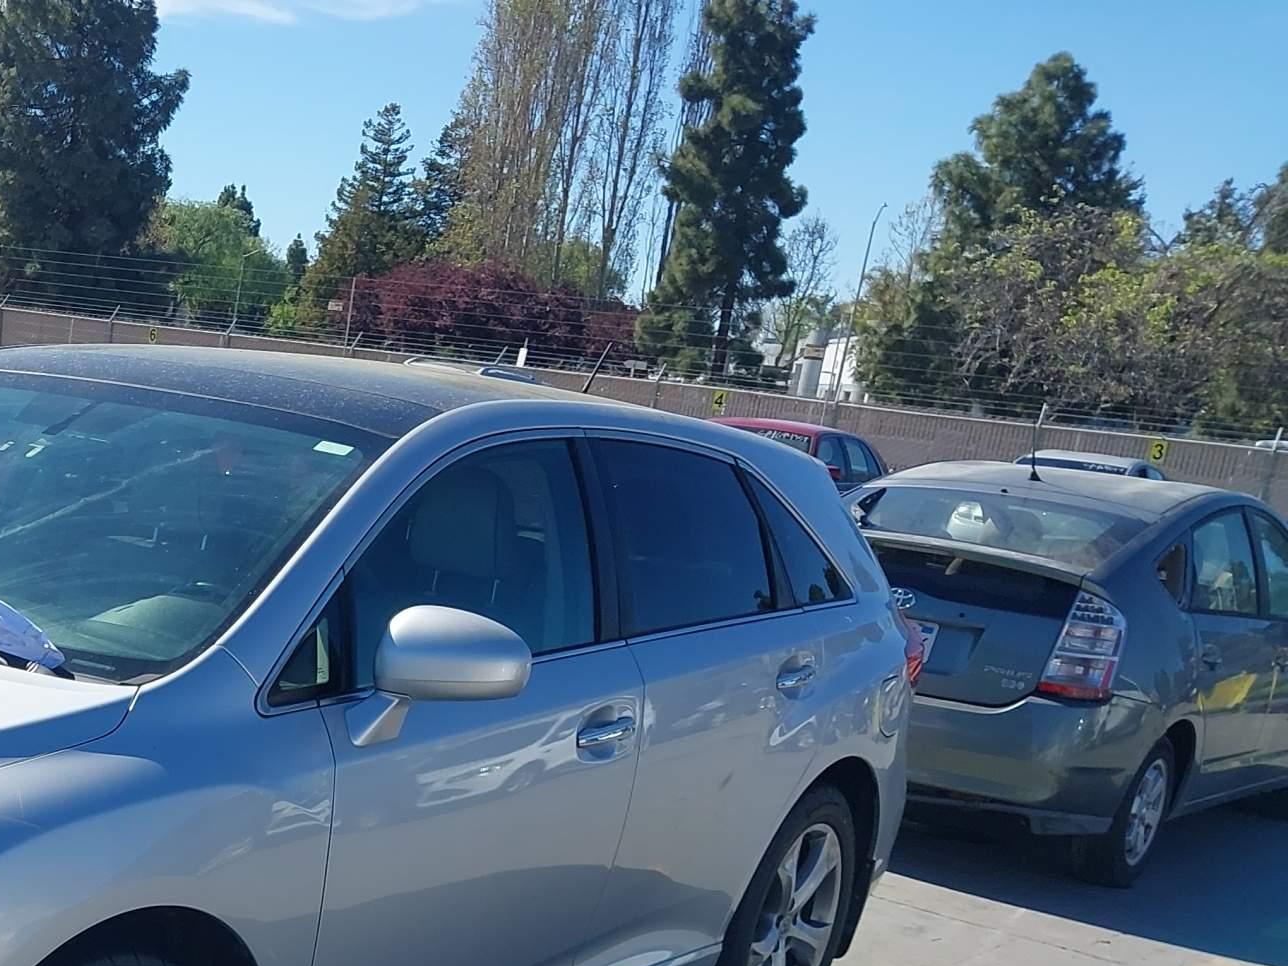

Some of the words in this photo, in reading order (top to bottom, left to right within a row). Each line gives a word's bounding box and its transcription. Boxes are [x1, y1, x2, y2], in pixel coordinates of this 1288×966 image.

[149, 328, 156, 341] 6
[714, 393, 724, 408] 4
[1152, 443, 1165, 460] 3
